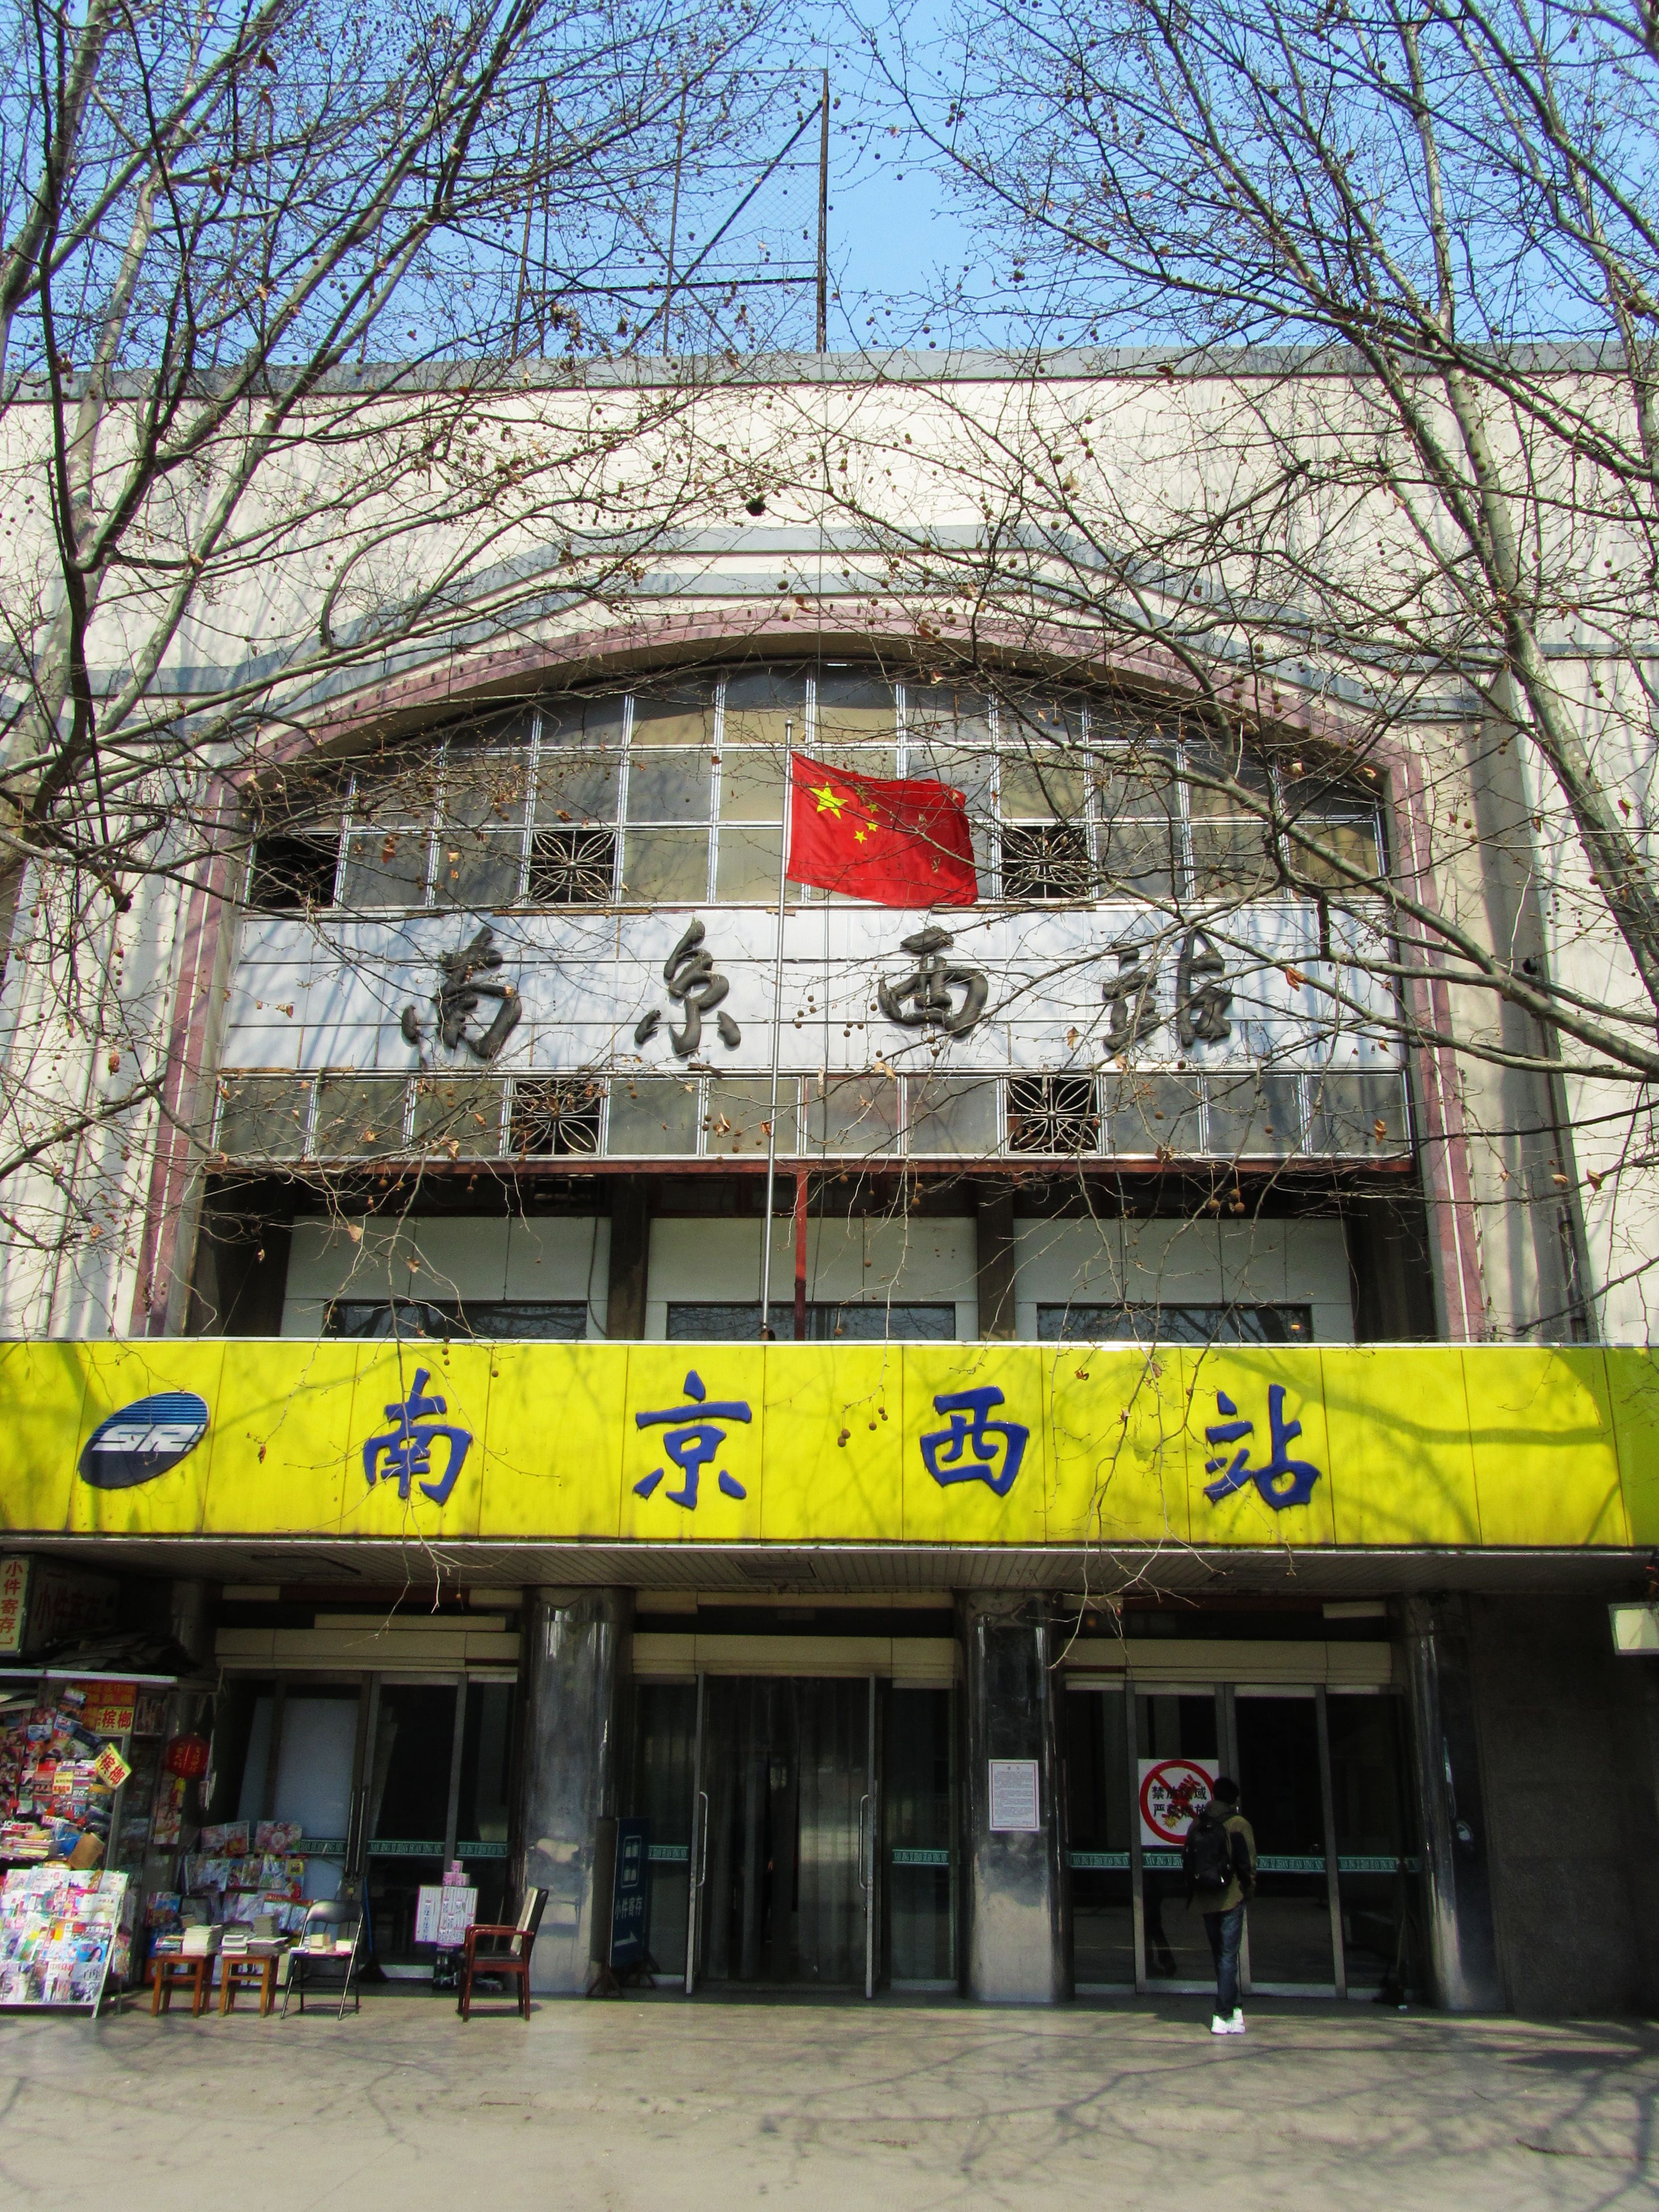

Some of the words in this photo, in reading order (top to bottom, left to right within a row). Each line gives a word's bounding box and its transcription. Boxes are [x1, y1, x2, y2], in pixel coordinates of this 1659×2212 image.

[363, 1368, 1321, 1509] 南京西站
[0, 1561, 23, 1633] 小件寄存
[1152, 1785, 1207, 1800] 禁域
[614, 1896, 643, 1920] 小件寄存
